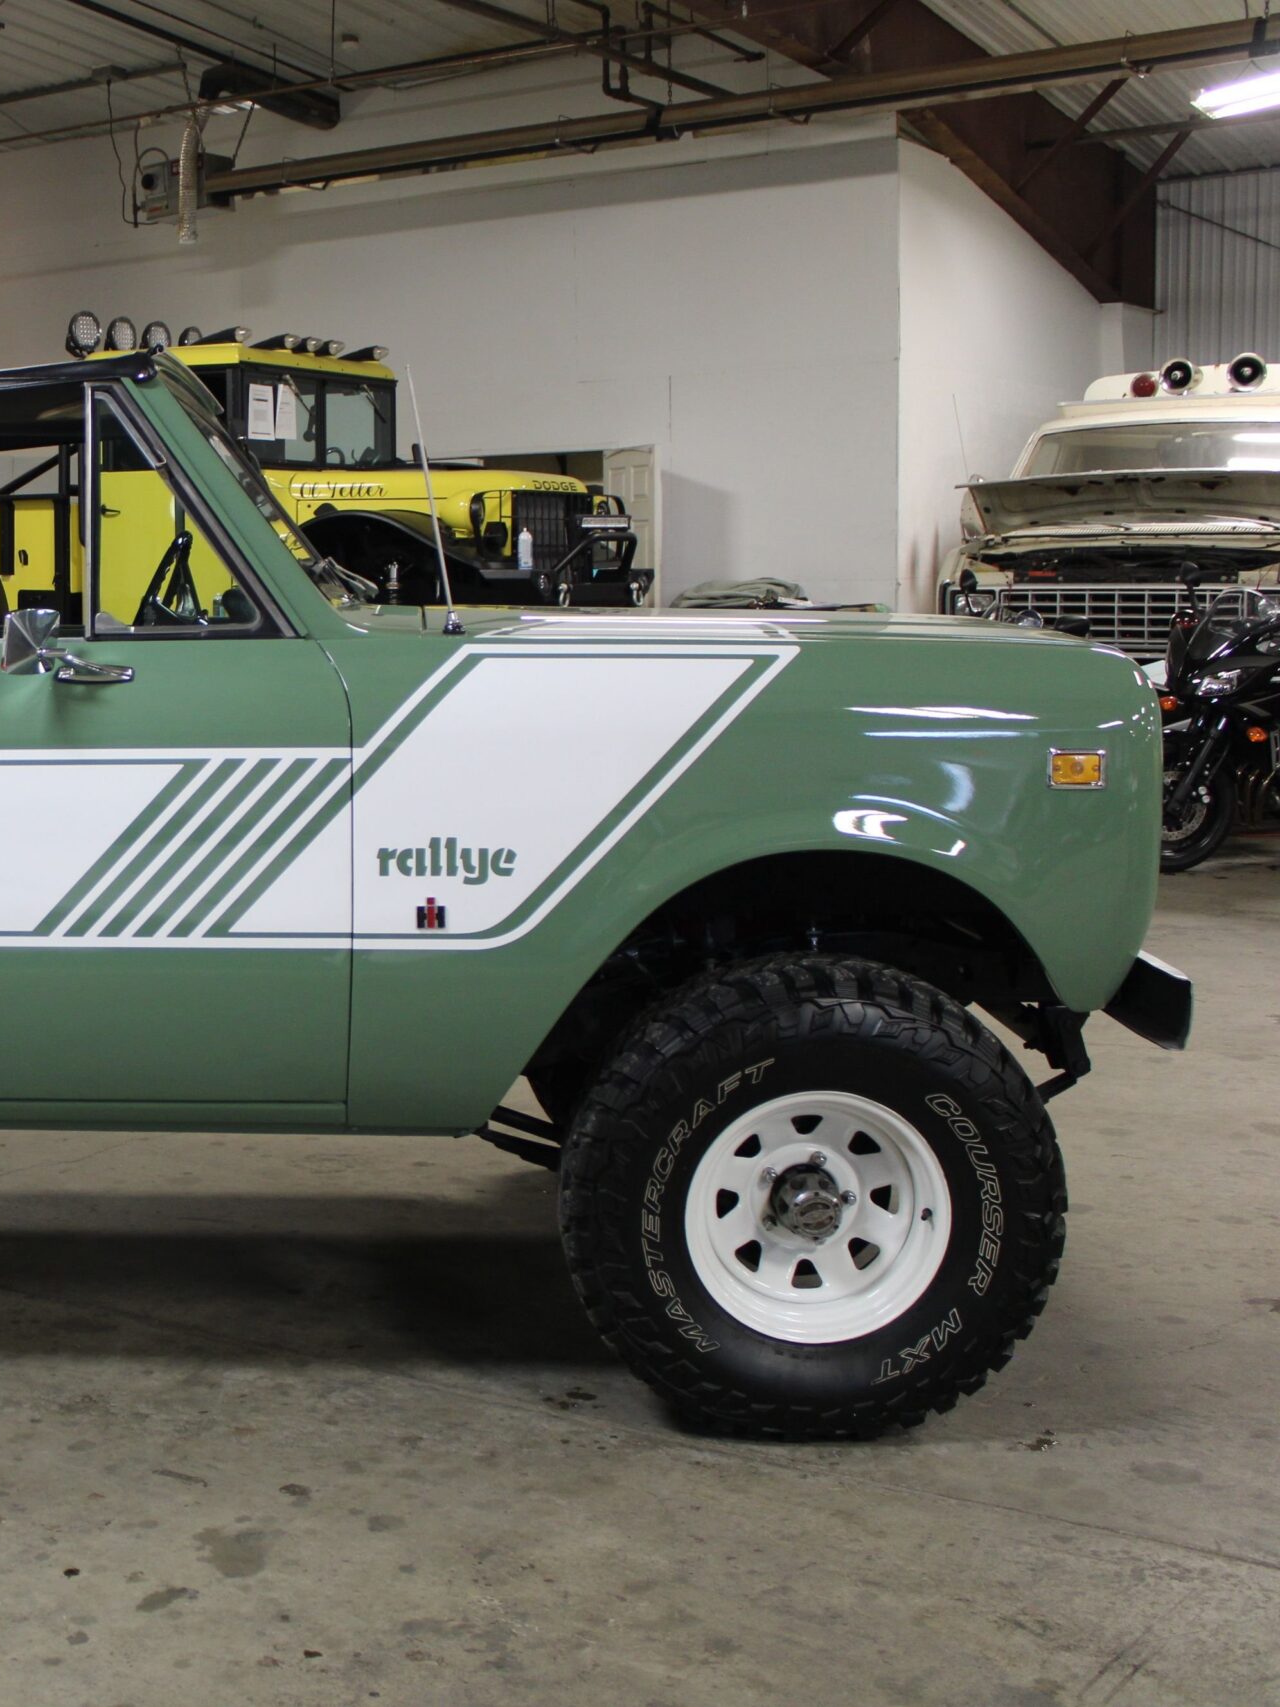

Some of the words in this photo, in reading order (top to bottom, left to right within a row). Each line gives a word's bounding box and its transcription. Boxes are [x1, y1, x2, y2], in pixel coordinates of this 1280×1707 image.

[326, 480, 388, 499] Yeller
[532, 480, 578, 492] DODGE
[376, 836, 518, 886] rallye
[640, 1057, 776, 1354] MASTERCRAFT
[924, 1092, 1006, 1297] COURSER
[870, 1307, 963, 1386] MXT
